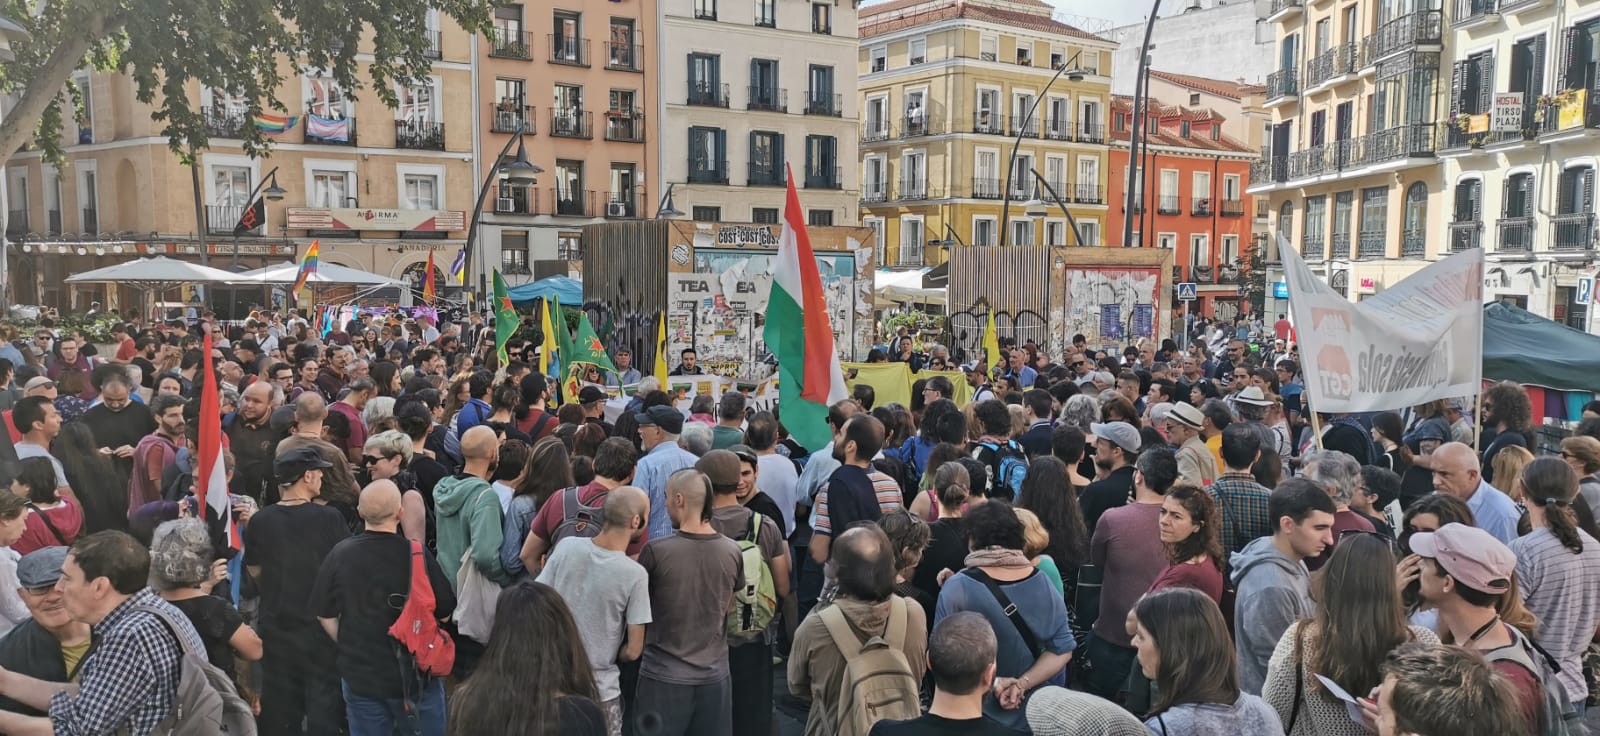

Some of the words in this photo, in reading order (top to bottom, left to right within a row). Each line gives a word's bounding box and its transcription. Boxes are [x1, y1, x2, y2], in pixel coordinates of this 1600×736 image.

[1496, 96, 1521, 105] HOSTAL
[1496, 107, 1520, 116] TIRSO
[1495, 117, 1520, 126] PLAZA
[718, 232, 737, 243] COST
[740, 231, 759, 242] COST
[678, 280, 709, 293] TEA
[736, 281, 757, 293] EA
[1580, 280, 1588, 300] P
